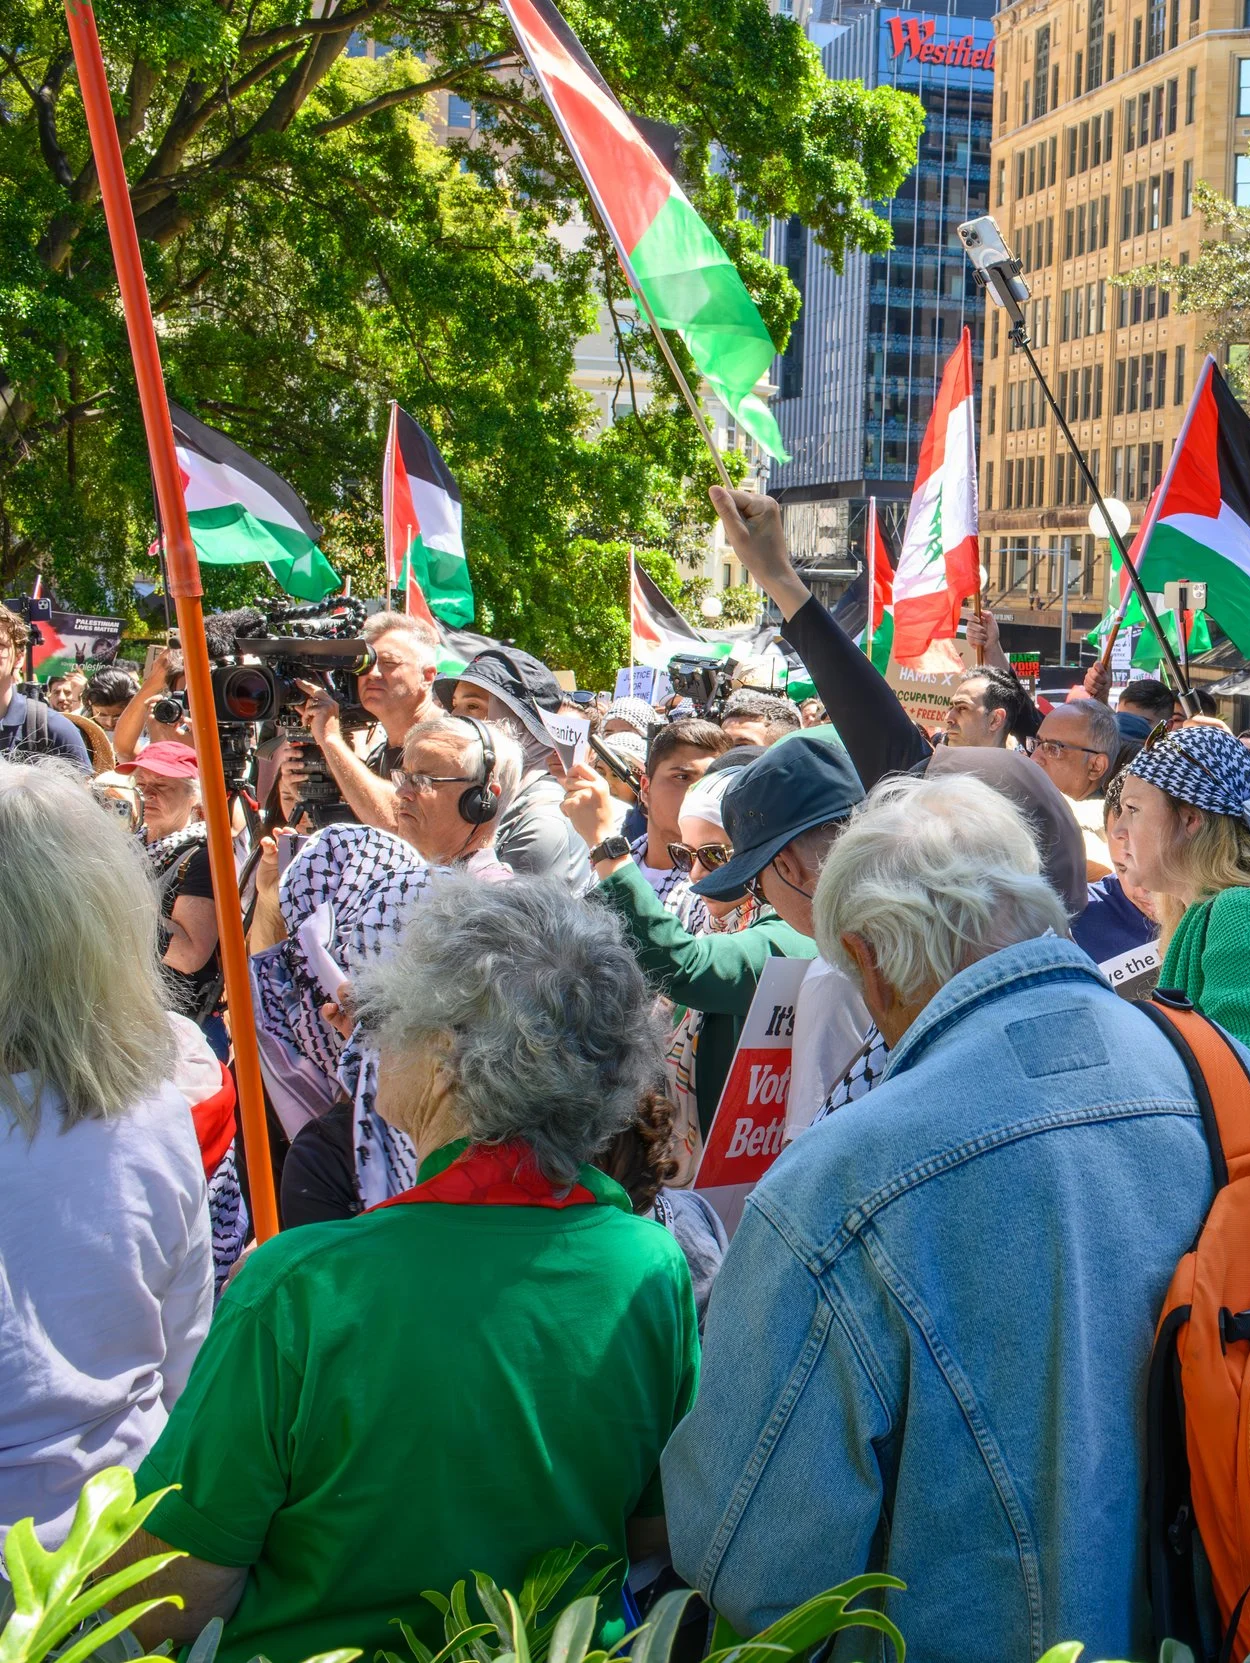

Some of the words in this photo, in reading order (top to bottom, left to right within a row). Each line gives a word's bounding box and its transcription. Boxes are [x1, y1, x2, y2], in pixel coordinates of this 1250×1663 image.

[886, 16, 995, 70] Westfiel
[75, 618, 120, 628] PALESTINIAN
[899, 667, 937, 684] HAMAS
[1010, 662, 1040, 671] YOUR
[1125, 955, 1155, 974] the
[747, 1064, 791, 1105] Vot
[725, 1117, 785, 1159] Bett
